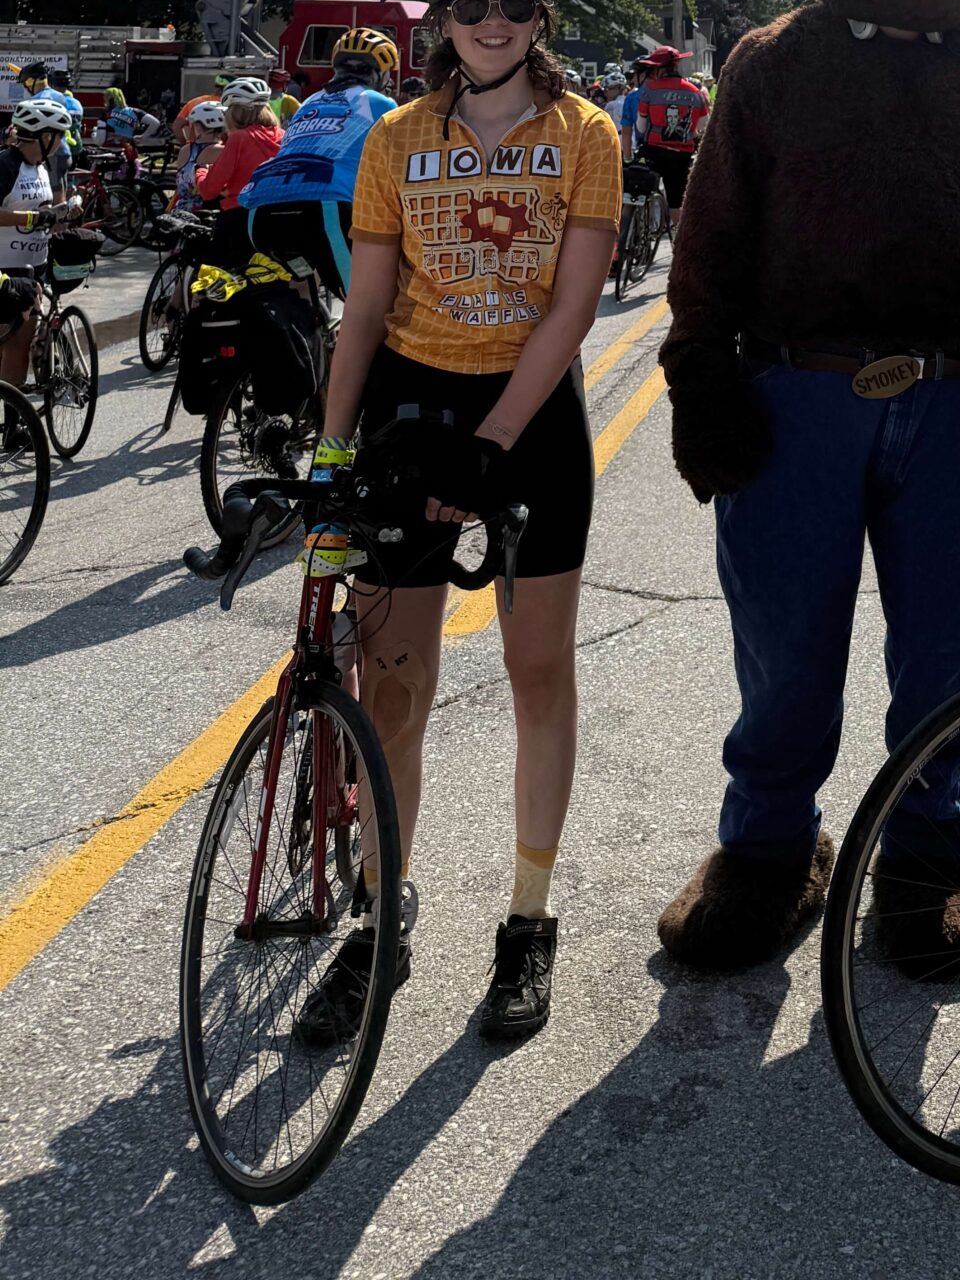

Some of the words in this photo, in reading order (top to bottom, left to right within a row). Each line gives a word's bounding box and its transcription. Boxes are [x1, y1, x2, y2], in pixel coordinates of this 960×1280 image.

[418, 146, 559, 177] IOWA
[443, 291, 497, 307] FLAT
[451, 305, 539, 323] WAFFLE
[855, 360, 916, 394] SMOKEY
[308, 583, 321, 641] TREK
